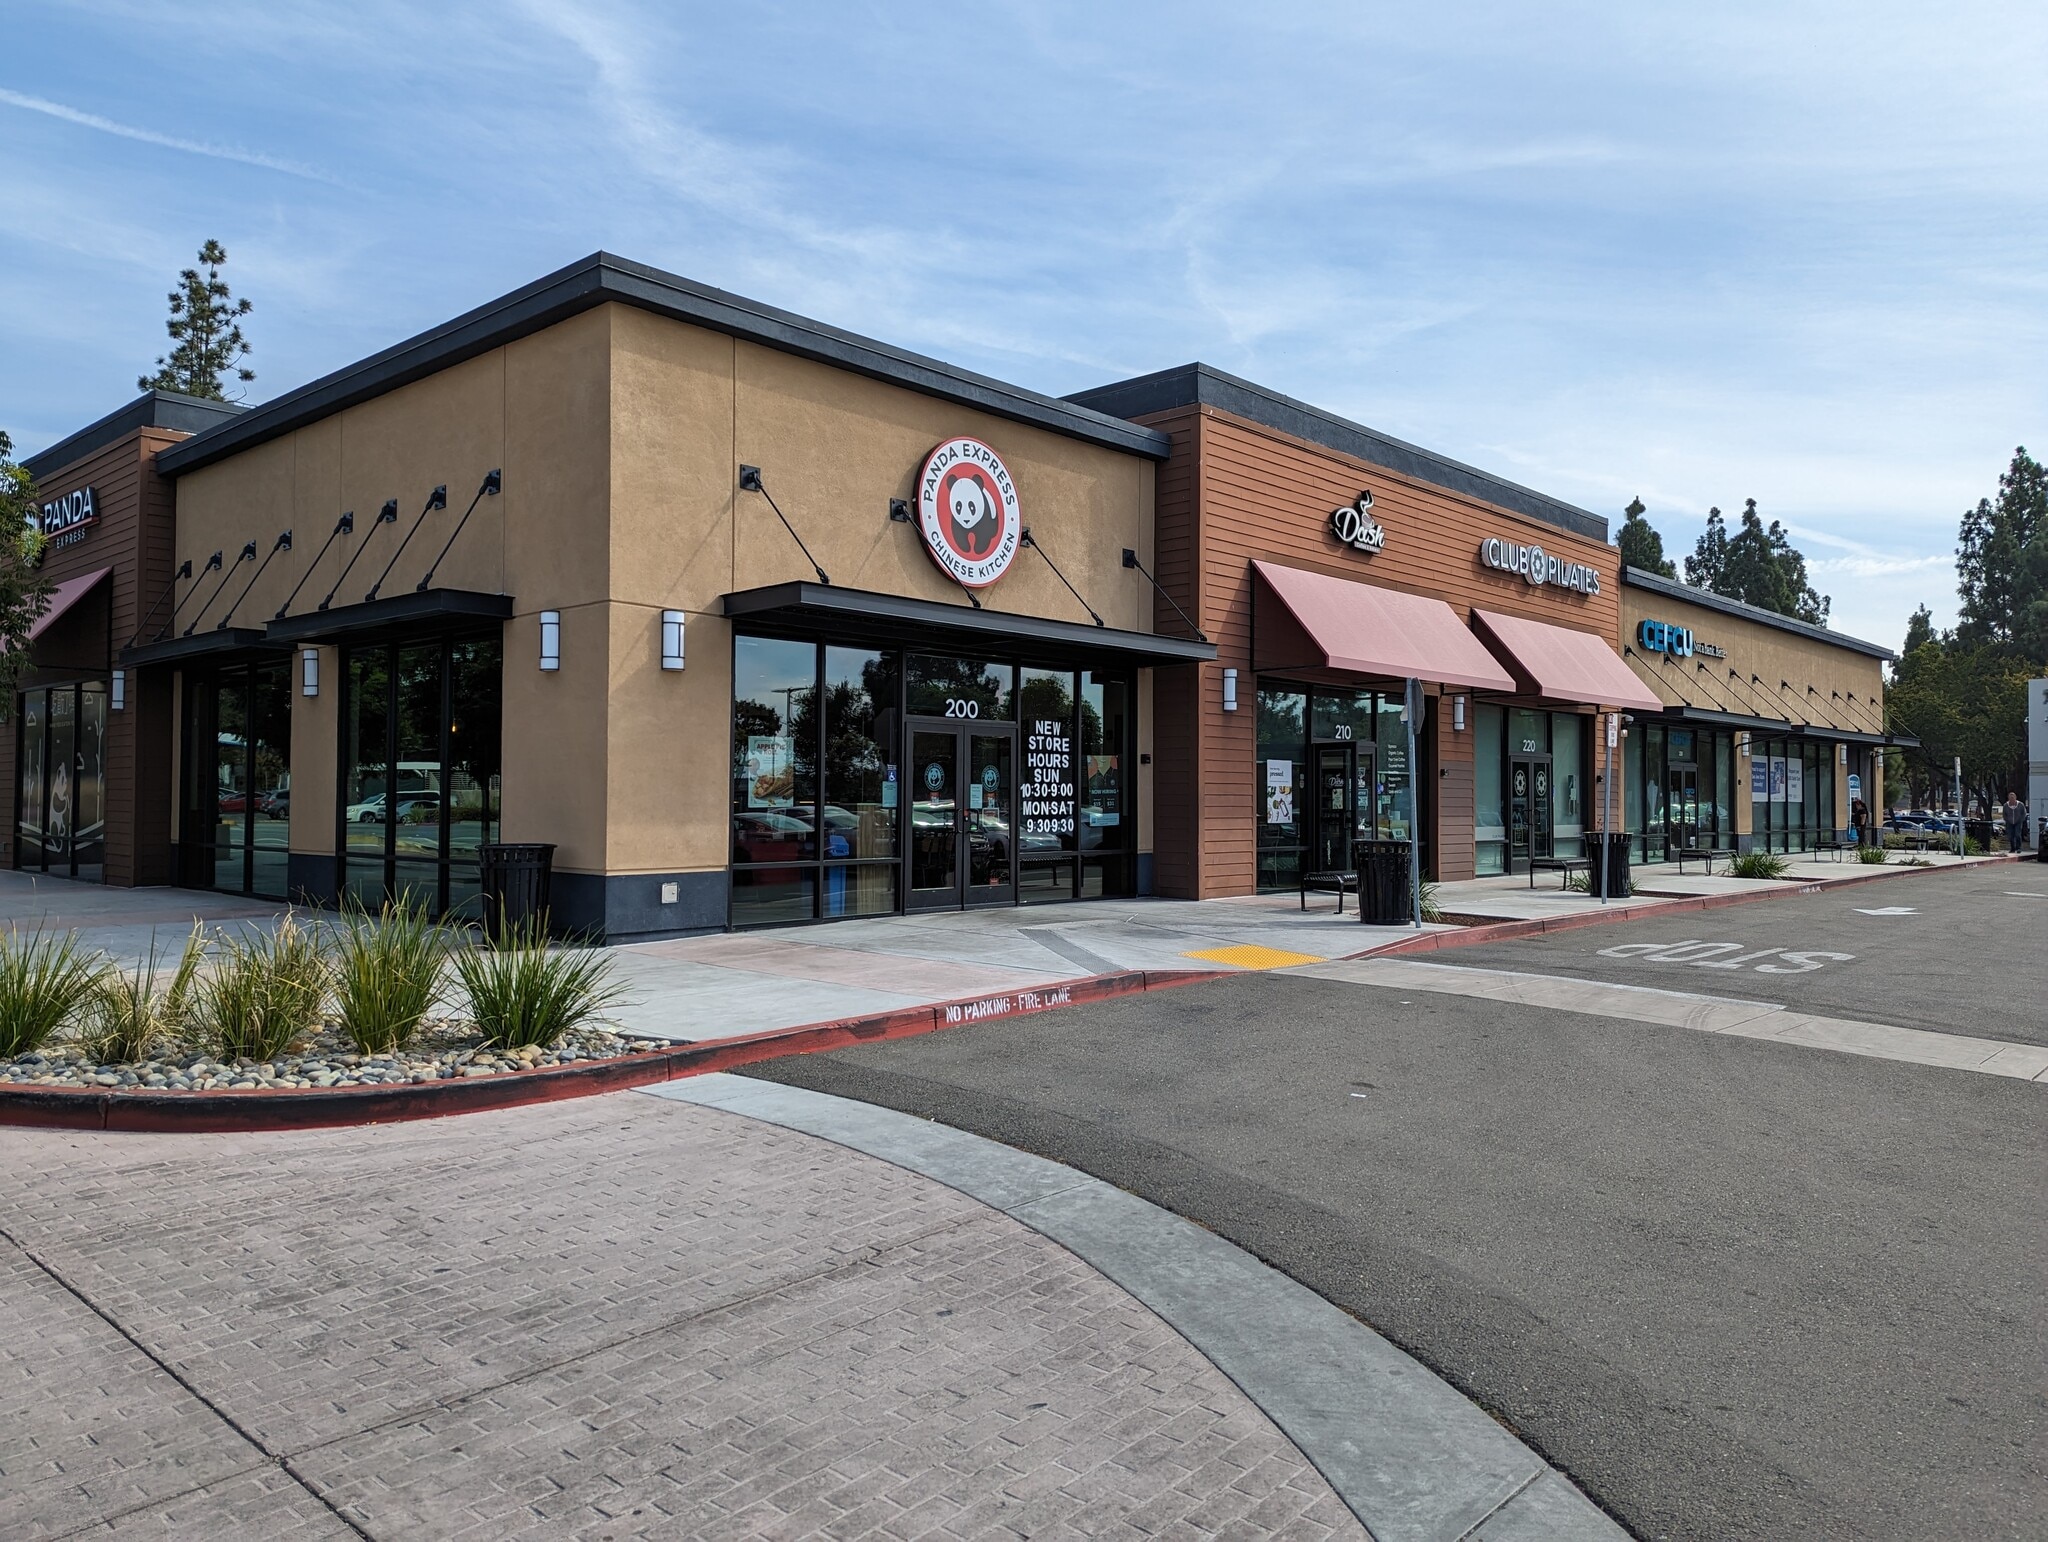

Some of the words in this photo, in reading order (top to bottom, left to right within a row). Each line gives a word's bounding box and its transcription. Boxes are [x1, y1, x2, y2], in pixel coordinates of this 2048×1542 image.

[924, 446, 958, 502] PANDA
[963, 444, 1015, 506] EXPRESS
[44, 486, 93, 533] PANDA
[1335, 507, 1385, 548] Dash
[56, 528, 86, 549] EXPRESS
[931, 531, 974, 578] CHINESE
[979, 532, 1015, 578] KITCHEN
[1488, 538, 1528, 574] CLUB
[1548, 555, 1600, 595] PILATES
[1643, 619, 1694, 658] CEFCU
[945, 698, 979, 719] 200
[1035, 720, 1061, 736] NEW
[1335, 725, 1352, 740] 210
[1028, 735, 1070, 752] STORE
[1523, 740, 1536, 752] 220
[1028, 753, 1070, 768] HOURS
[1034, 768, 1060, 783] SUN
[1020, 783, 1073, 798] 10:30-9:00
[1022, 801, 1075, 816] MON-SAT
[1596, 940, 1856, 974] STOP
[946, 1005, 961, 1023] NO
[964, 997, 1010, 1020] PARKING
[1018, 992, 1041, 1011] FIRE
[1045, 986, 1071, 1006] LANE
